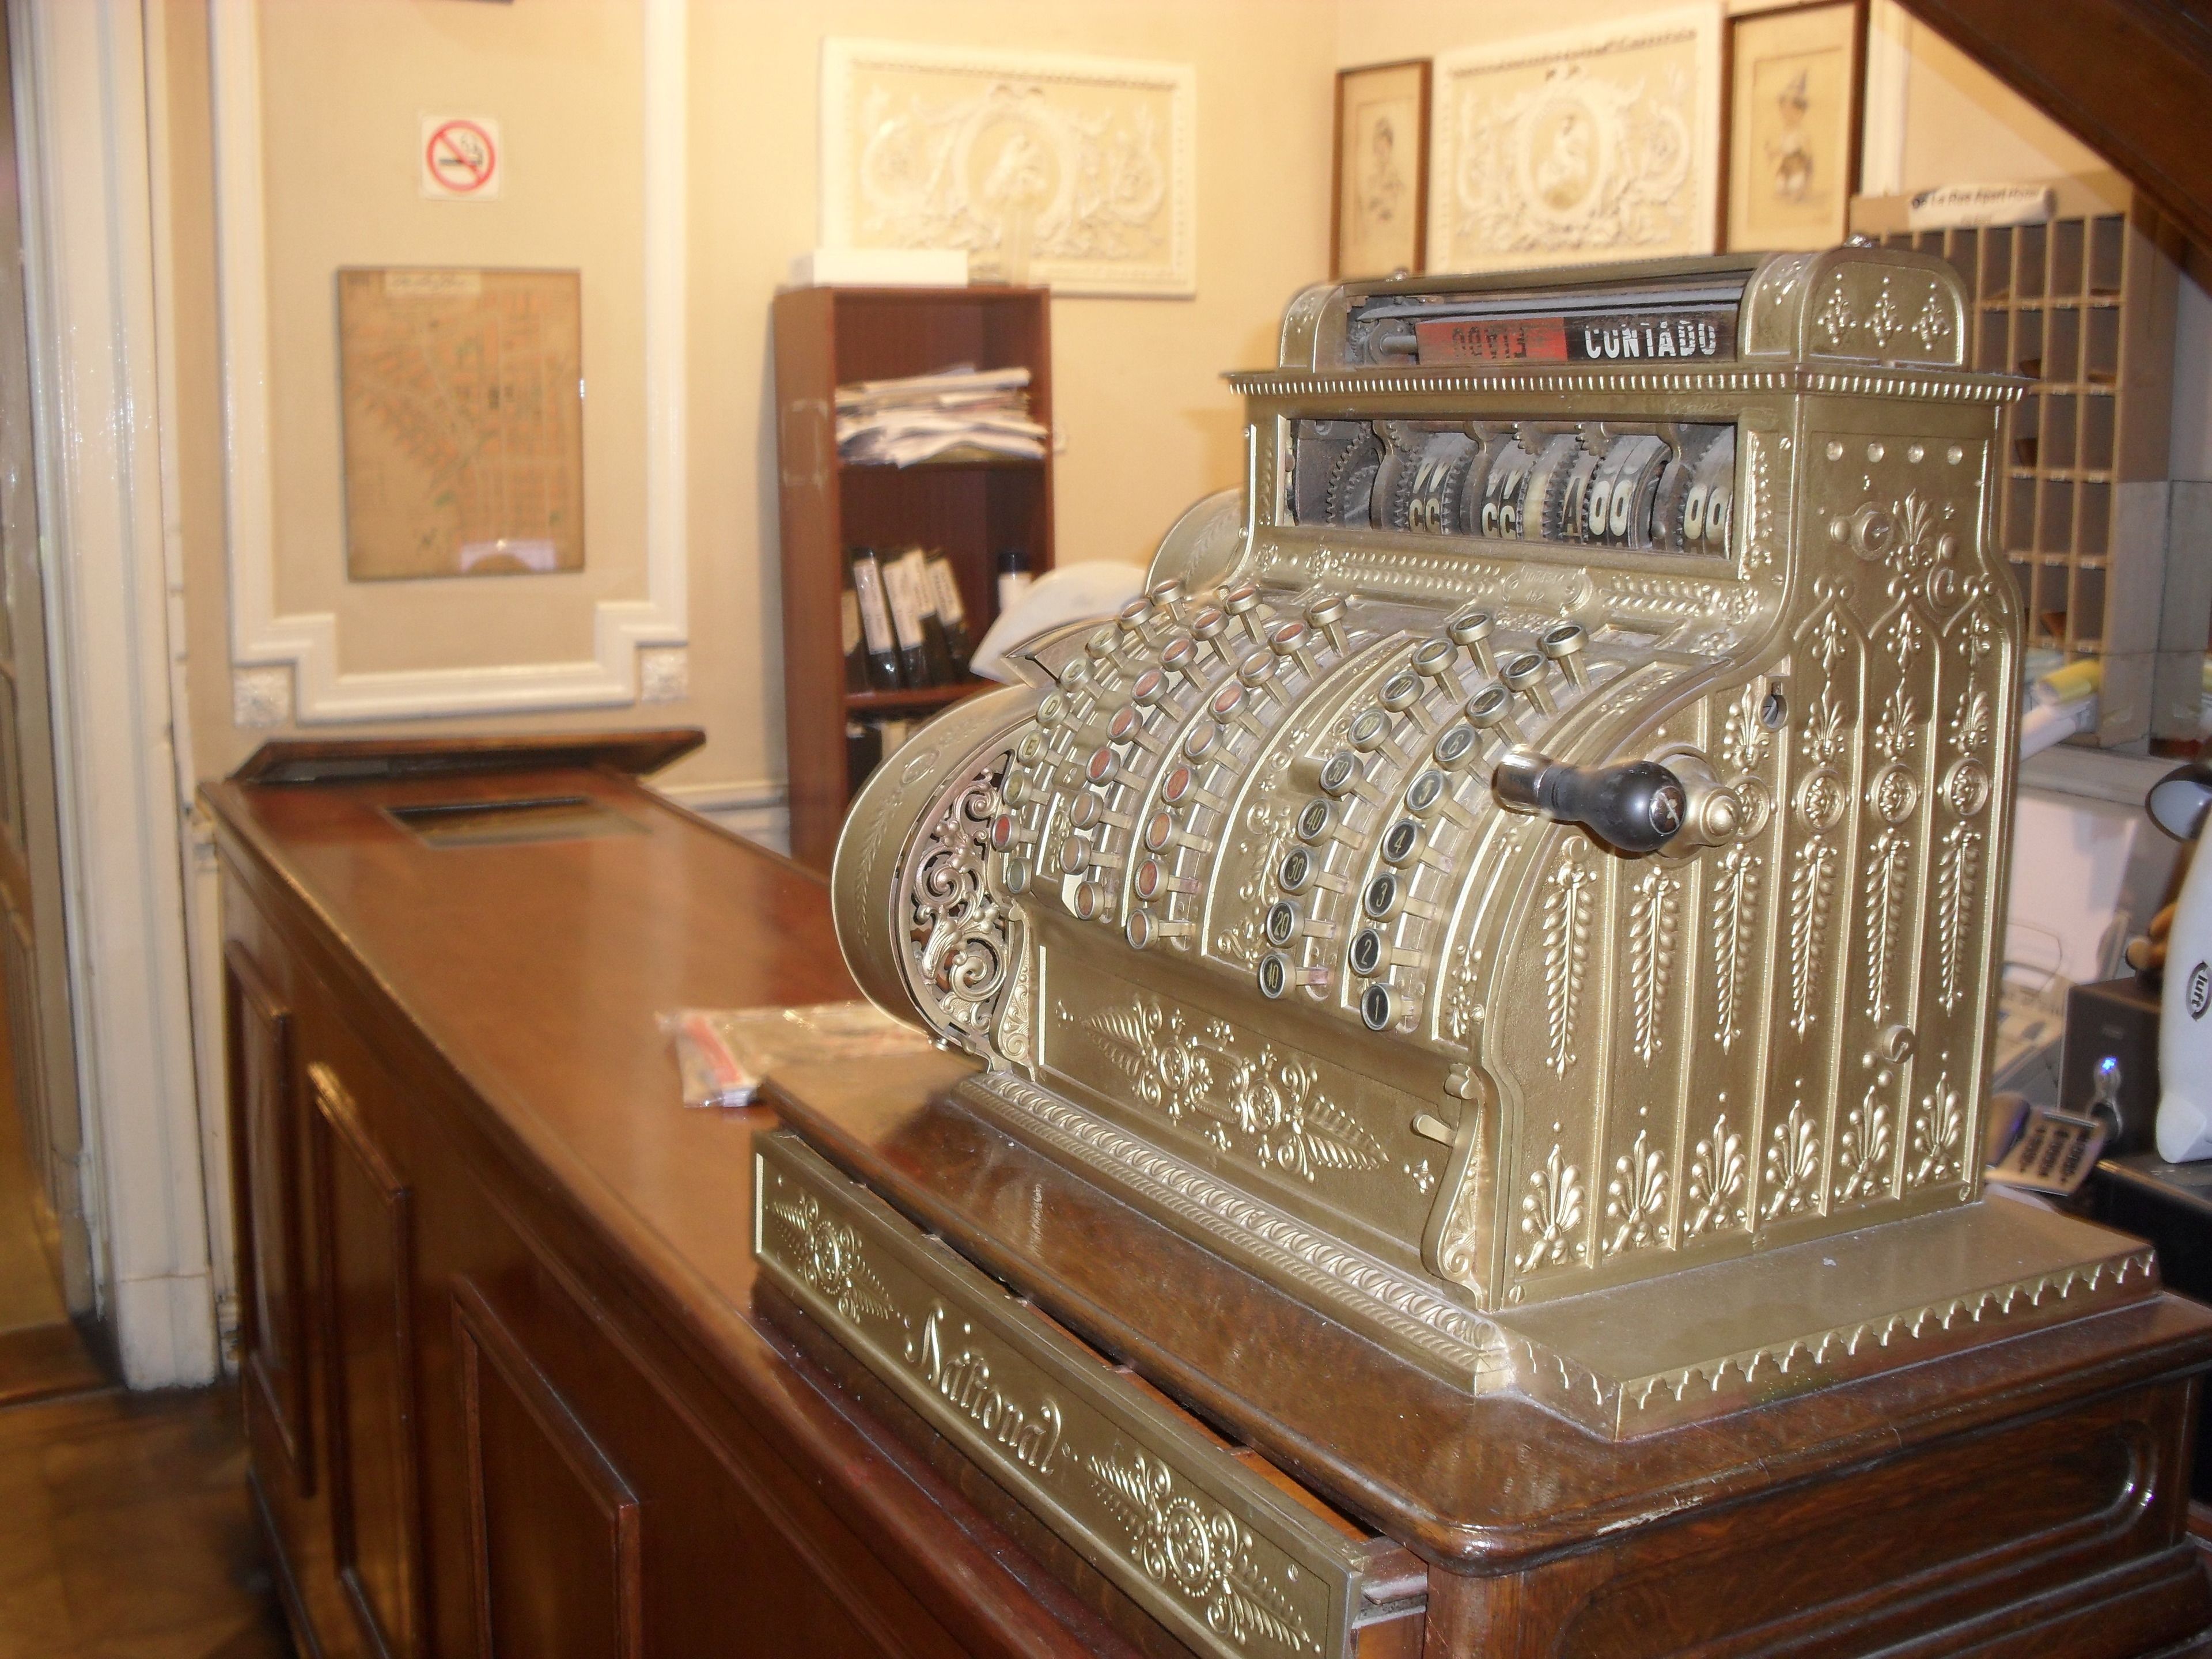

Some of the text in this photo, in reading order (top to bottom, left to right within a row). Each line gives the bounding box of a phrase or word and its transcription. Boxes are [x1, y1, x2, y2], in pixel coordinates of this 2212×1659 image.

[1045, 699, 1058, 715] D
[1025, 739, 1037, 755] E
[1448, 734, 1464, 755] 6
[1328, 760, 1349, 782] 50
[1419, 779, 1434, 804] 5
[1306, 807, 1324, 831] 40
[1394, 830, 1407, 853] 4
[1287, 857, 1305, 881] 30
[1376, 882, 1388, 907] 3
[1274, 911, 1290, 938] 20
[1361, 939, 1372, 965] 2
[1268, 962, 1279, 989] 10
[2191, 974, 2208, 1007] luft
[905, 1305, 1062, 1475] National
